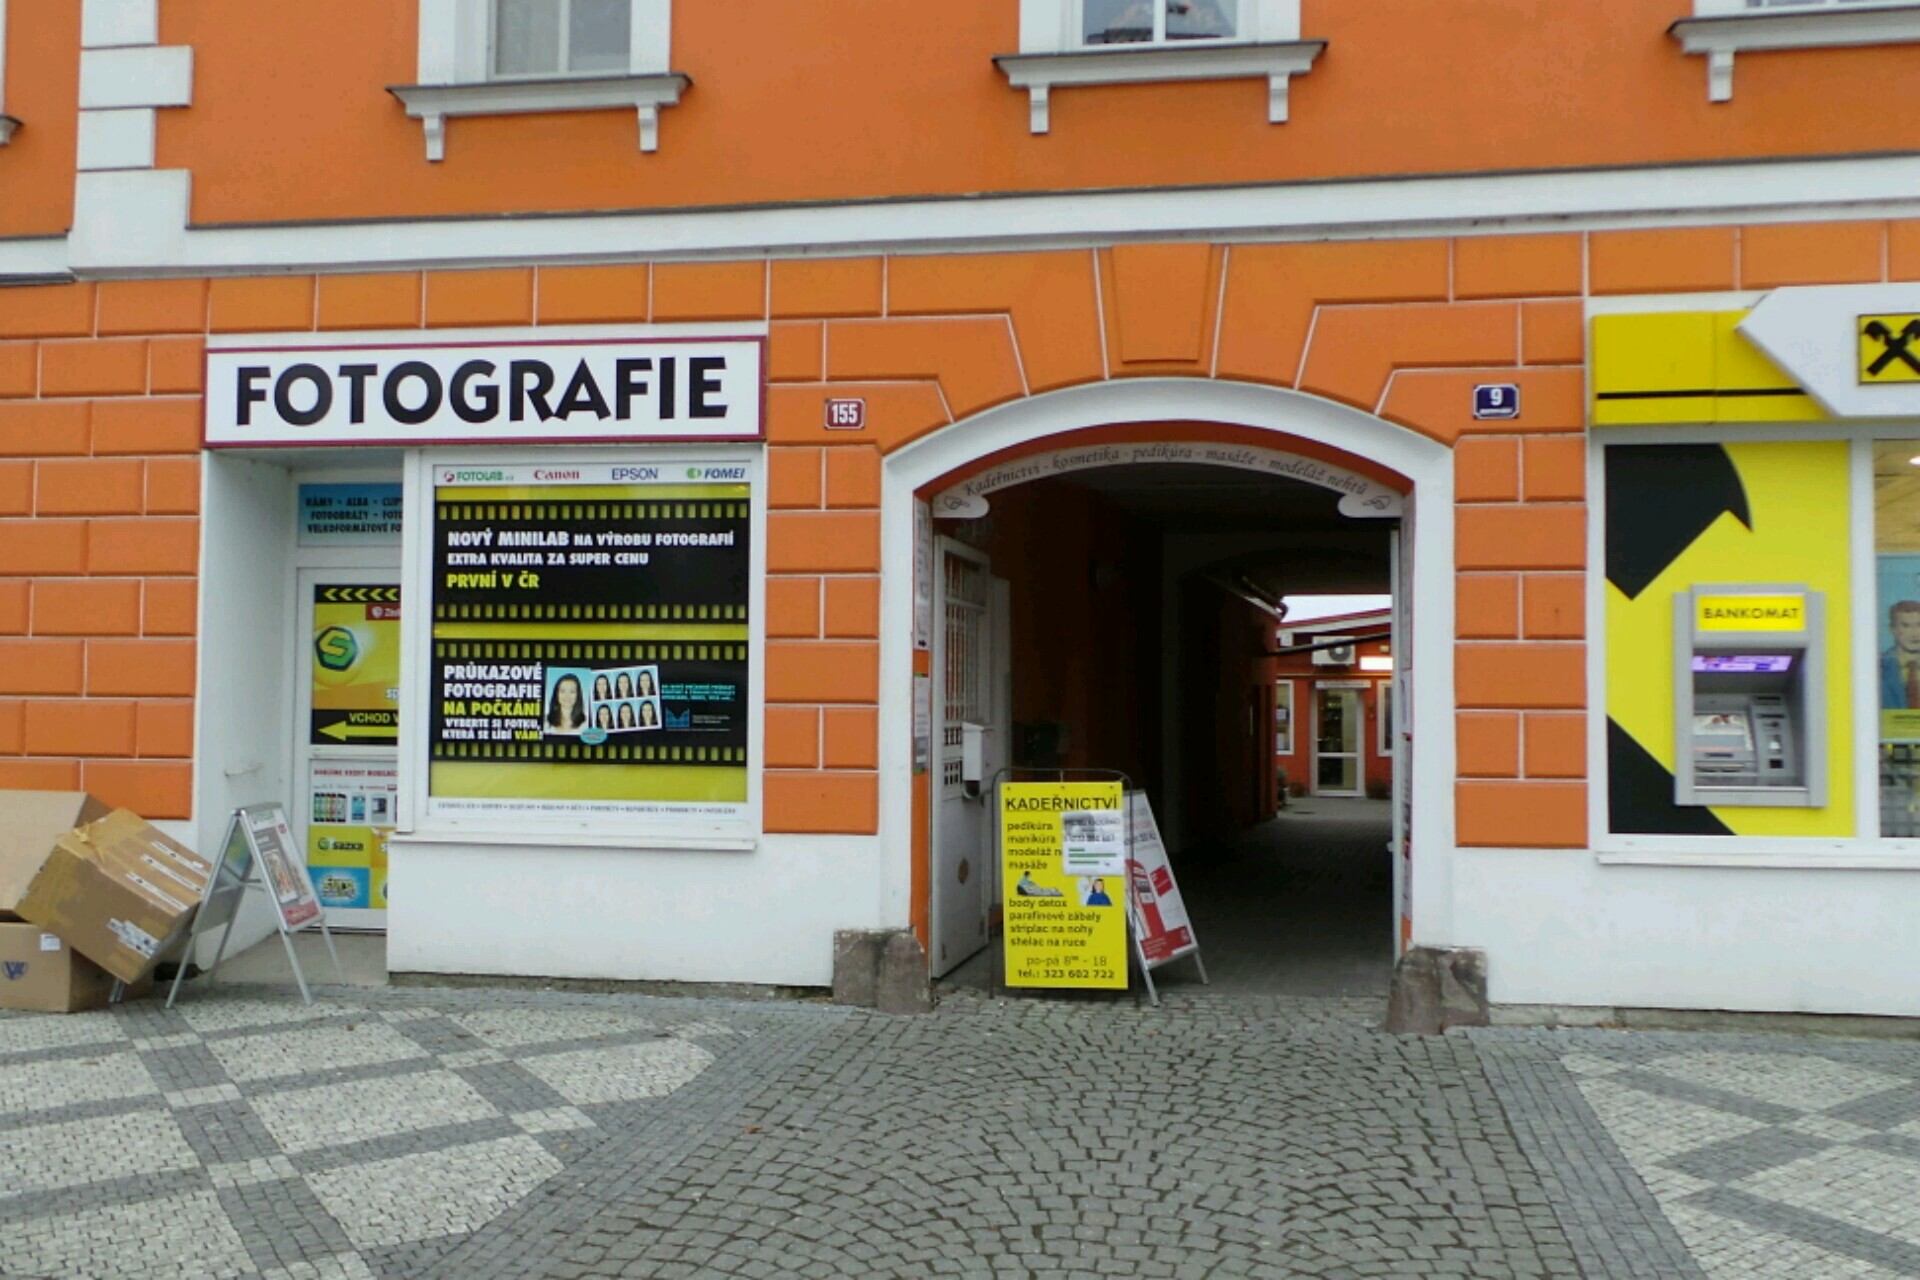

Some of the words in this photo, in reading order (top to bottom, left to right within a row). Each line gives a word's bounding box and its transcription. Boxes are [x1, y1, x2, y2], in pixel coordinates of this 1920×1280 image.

[236, 357, 729, 426] FOTOGRAFIE
[1490, 388, 1503, 406] 9
[831, 403, 858, 424] 155
[534, 469, 580, 480] Canon
[611, 467, 659, 480] EPSON
[704, 467, 746, 479] FOMEI
[1051, 446, 1120, 470] kosmetika
[1131, 443, 1193, 462] pedikúra
[1205, 448, 1257, 466] masáže
[1268, 458, 1327, 481] modeláž
[1326, 474, 1369, 495] nehtů
[447, 528, 493, 546] NOVÝ
[498, 531, 570, 547] MINILAB
[573, 534, 593, 547] NA
[596, 530, 652, 547] VÝROBU
[655, 530, 735, 547] FOTOGRAFIÍ
[447, 552, 487, 566] EXTRA
[491, 552, 544, 566] KVALITA
[547, 552, 566, 566] ZA
[569, 552, 611, 566] SUPER
[614, 552, 649, 565] CENU
[446, 570, 497, 588] PRVNÍ
[502, 574, 514, 588] V
[518, 569, 540, 588] ČR
[1703, 607, 1799, 619] BANKOMAT
[443, 661, 542, 680] PRŮKAZOVÉ
[443, 682, 542, 698] FOTOGRAFIE
[443, 700, 467, 716] NA
[471, 698, 541, 716] POČKÁNÍ
[349, 712, 390, 723] VCHOD
[445, 717, 489, 728] VYBERTE
[492, 718, 502, 728] SI
[505, 718, 541, 730] FOTKU,
[442, 727, 475, 740] KTERÁ
[477, 729, 489, 739] SE
[1005, 794, 1118, 811] KADEŘNICTVÍ
[1006, 821, 1053, 833] pedikúra
[1007, 834, 1056, 844] manikúra
[1008, 847, 1051, 856] modeláž
[1008, 860, 1048, 870] masáže
[1009, 898, 1035, 909] body
[1038, 898, 1068, 908] detox
[1009, 910, 1065, 921] parafinové
[1051, 925, 1065, 933] na
[1067, 924, 1094, 936] nohy
[1010, 937, 1043, 947] shelac
[1046, 938, 1060, 947] na
[1062, 939, 1087, 947] ruce
[1093, 955, 1108, 967] 18
[1043, 969, 1064, 978] 323
[1093, 970, 1115, 979] 722
